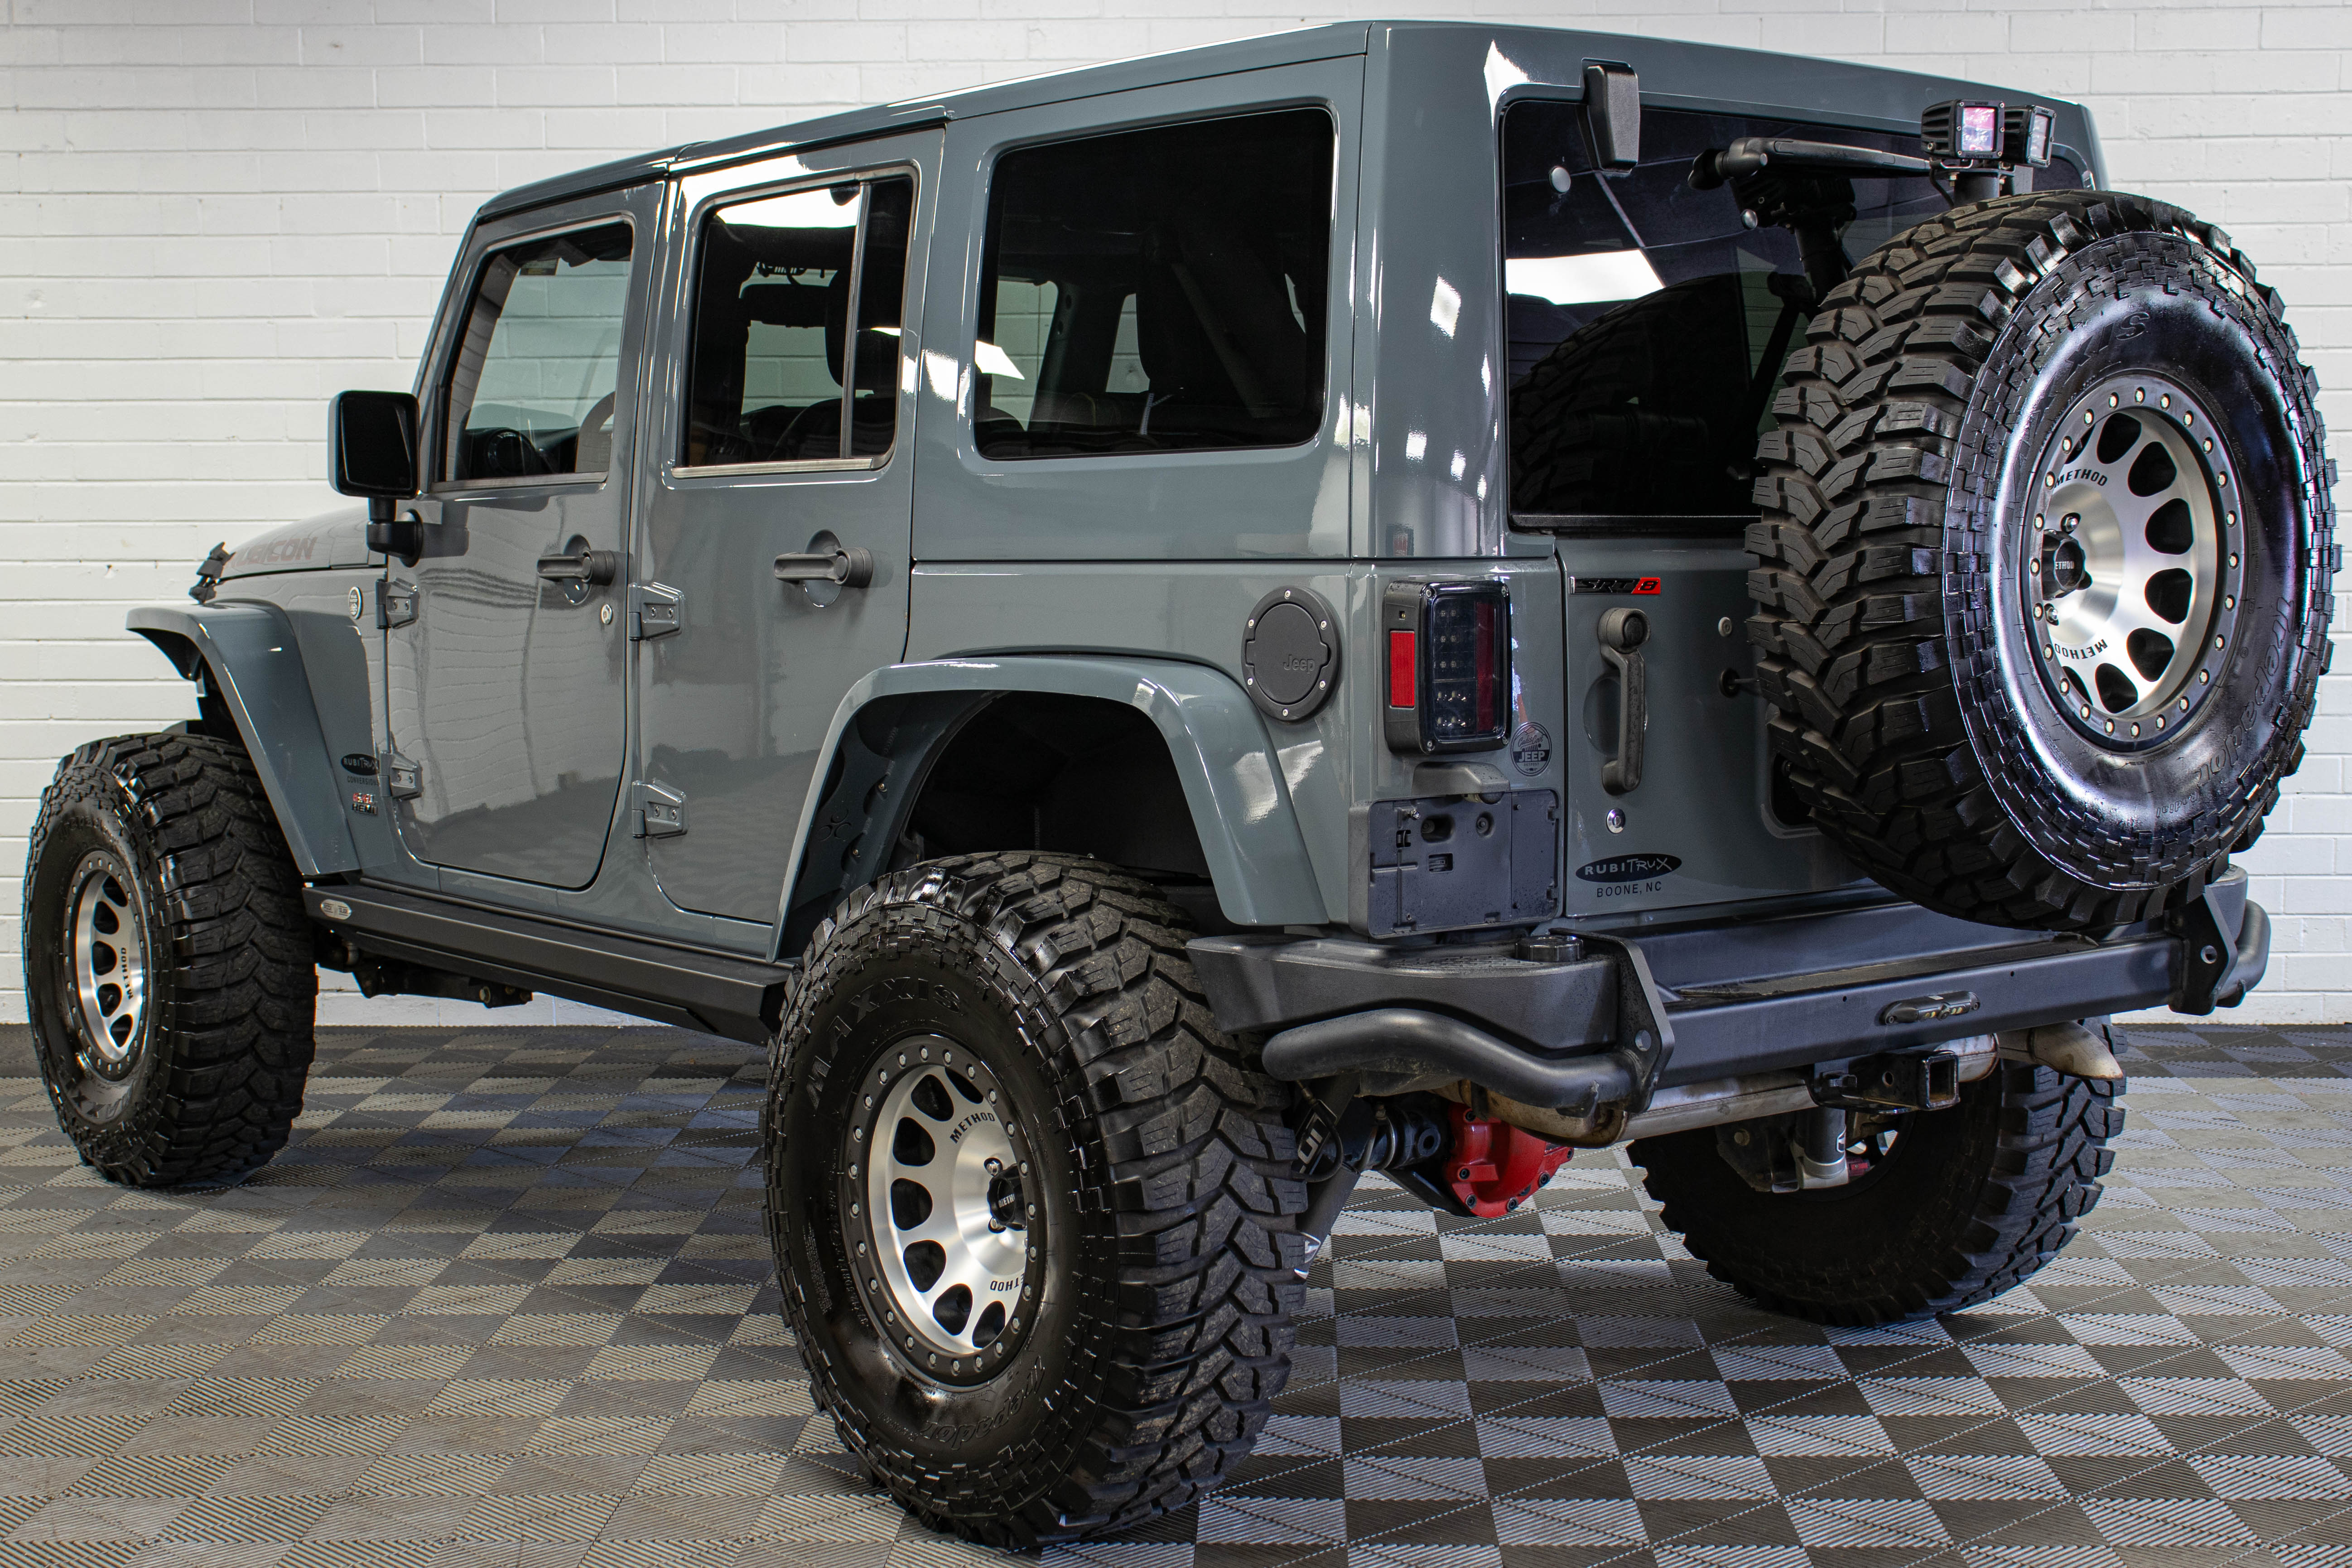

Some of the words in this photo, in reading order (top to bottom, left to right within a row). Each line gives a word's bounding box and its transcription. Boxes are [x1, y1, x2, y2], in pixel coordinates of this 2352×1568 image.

[2055, 468, 2108, 488] METHOD
[2055, 561, 2074, 570] ETHOD
[2054, 639, 2108, 660] METHOD
[1282, 654, 1315, 674] Jeep
[1518, 751, 1545, 762] JEEP
[1597, 883, 1642, 897] BOONE,
[1646, 881, 1662, 892] NC
[120, 947, 134, 999] METHOD
[805, 976, 961, 1110] MAXXIS
[949, 1112, 995, 1144] METHOD
